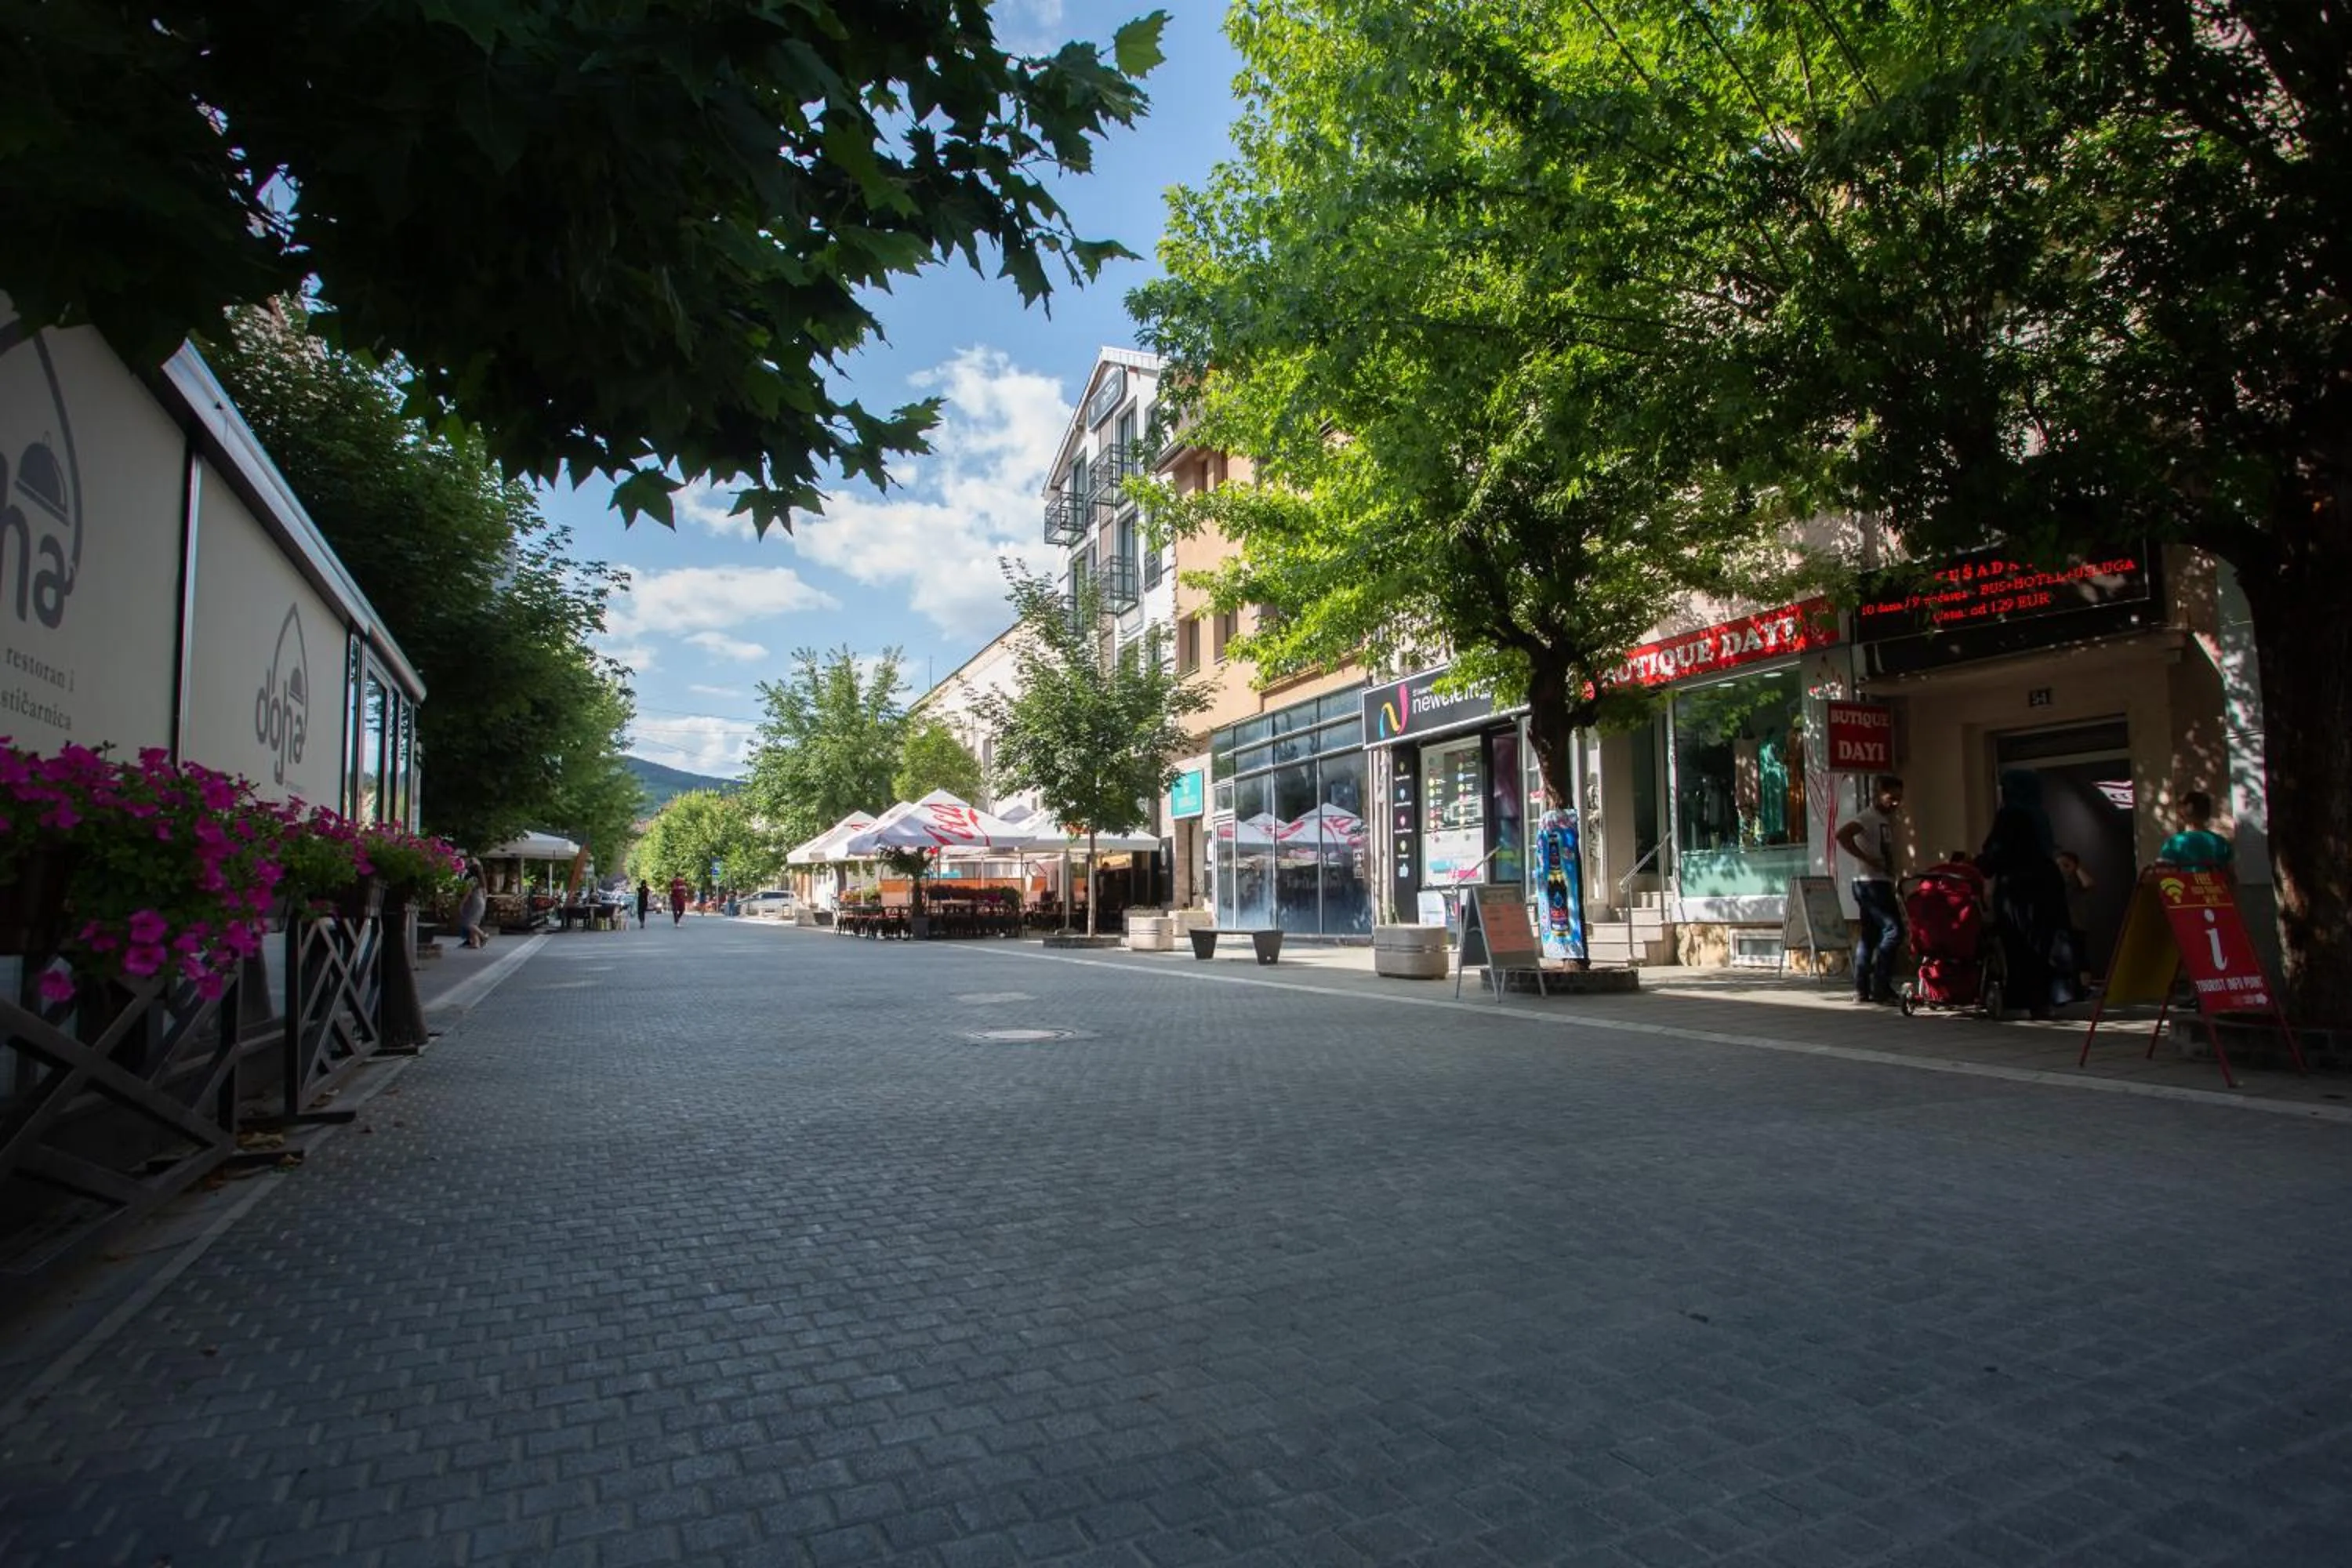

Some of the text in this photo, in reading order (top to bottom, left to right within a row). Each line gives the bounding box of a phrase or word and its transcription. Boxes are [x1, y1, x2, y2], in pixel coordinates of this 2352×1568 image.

[2017, 591, 2051, 608] EUR
[6, 645, 66, 689] restoran
[1831, 709, 1890, 728] BUTIQUE
[1838, 739, 1886, 763] DAYI
